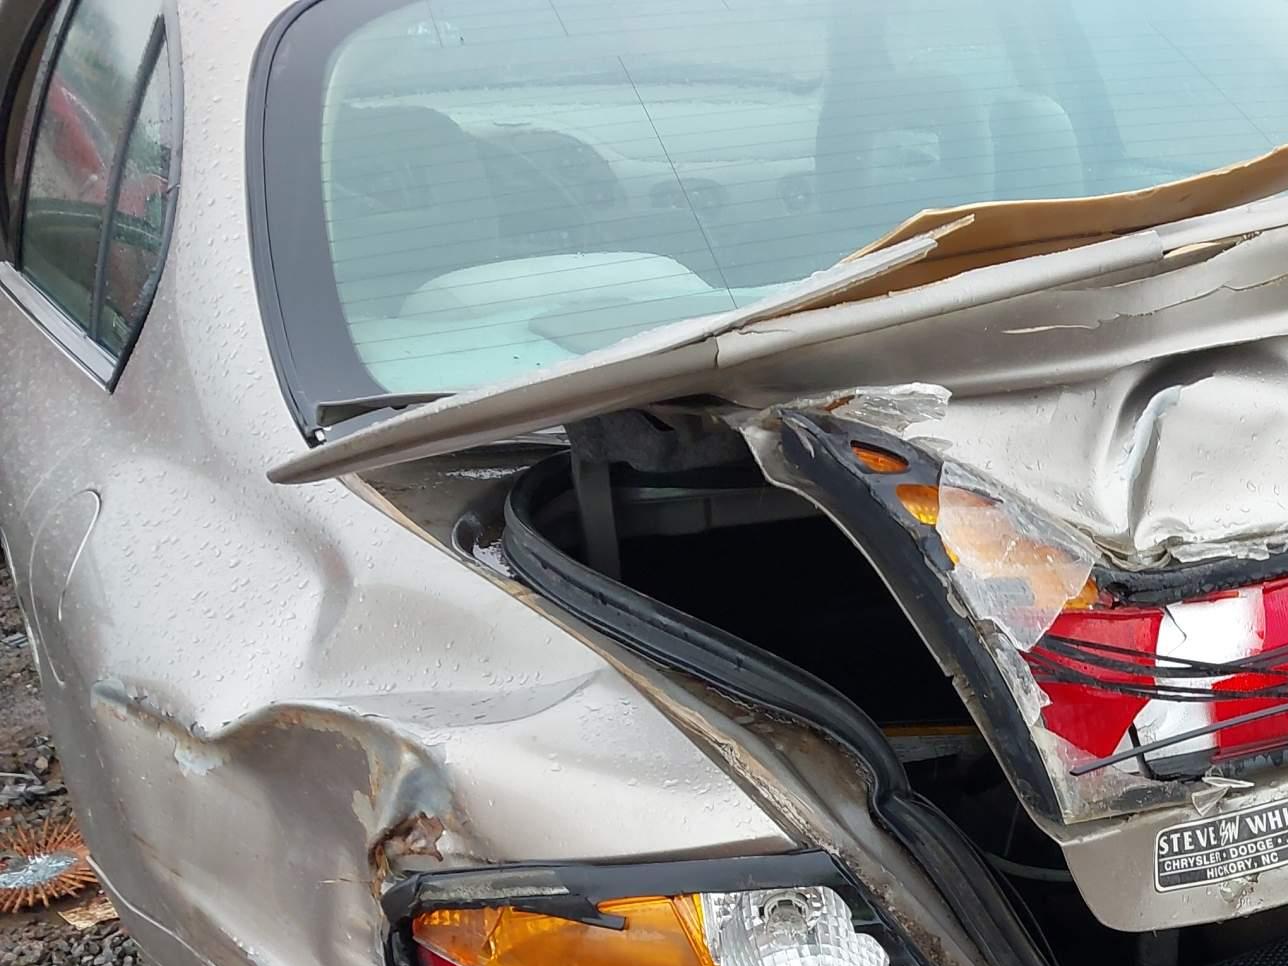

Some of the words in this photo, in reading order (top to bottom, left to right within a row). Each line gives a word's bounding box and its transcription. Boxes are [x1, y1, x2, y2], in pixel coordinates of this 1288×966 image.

[1159, 826, 1218, 855] STEVE
[1164, 851, 1222, 872] CHRYSLER
[1230, 838, 1274, 859] DODGE
[1206, 859, 1257, 880] HICKORY,
[1261, 852, 1279, 866] NC
